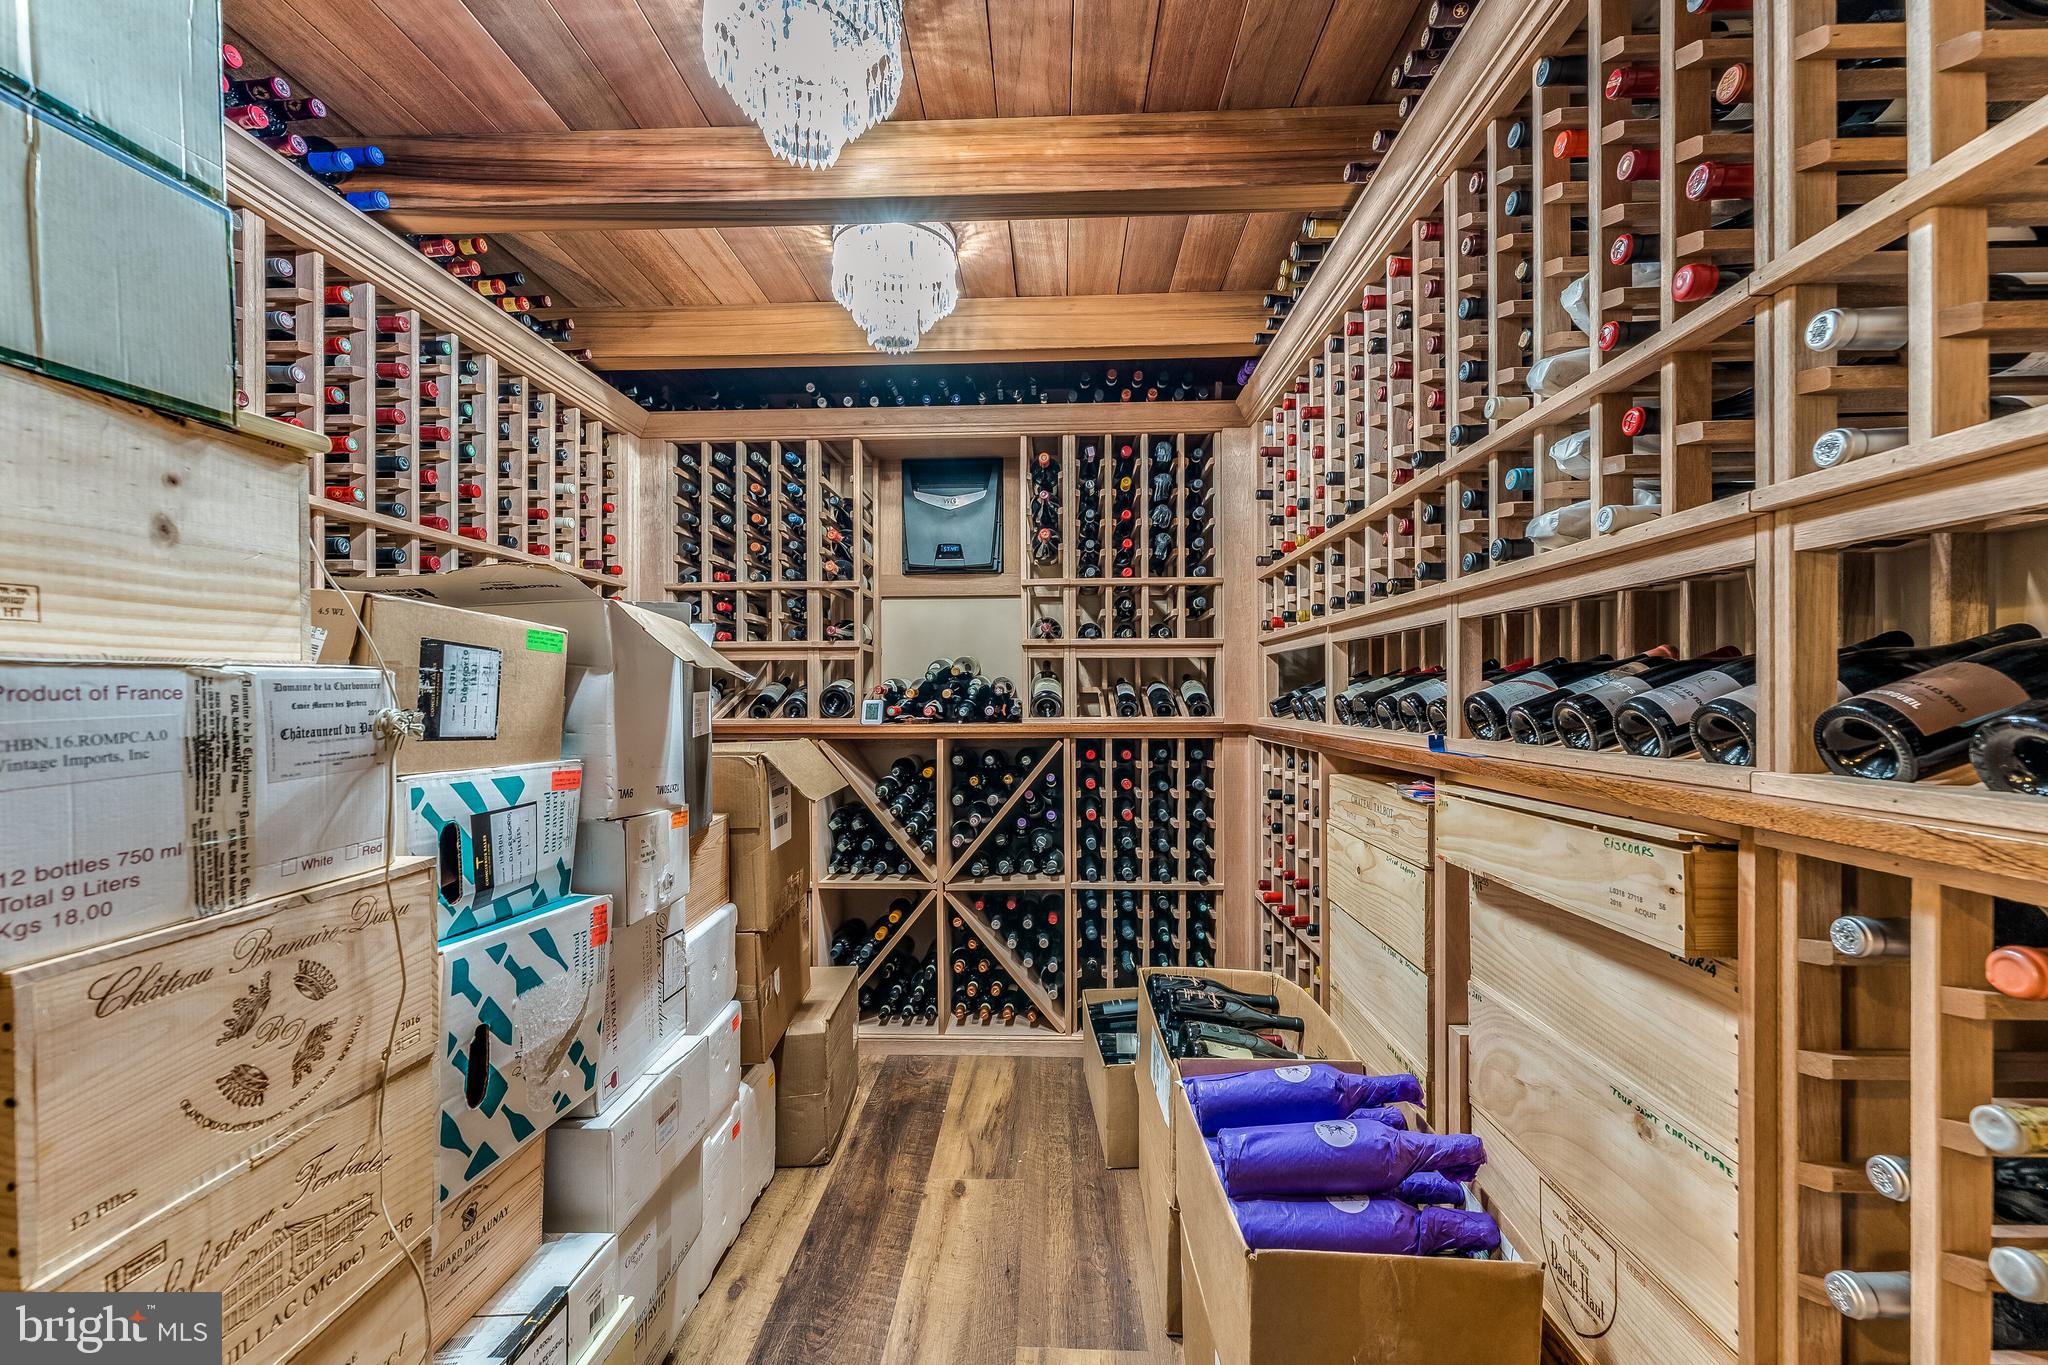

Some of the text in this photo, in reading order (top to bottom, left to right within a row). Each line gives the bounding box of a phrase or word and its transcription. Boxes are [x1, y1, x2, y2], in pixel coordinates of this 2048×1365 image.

[4, 607, 24, 617] HT
[332, 607, 345, 616] WL
[88, 685, 109, 701] of
[116, 685, 183, 701] France
[273, 682, 311, 692] Domaine
[313, 682, 322, 691] de
[324, 682, 332, 691] la
[280, 724, 342, 742] Châteauneuf
[345, 723, 356, 735] du
[62, 751, 125, 769] Imports,
[128, 749, 150, 761] Inc
[558, 800, 566, 850] winning
[362, 843, 383, 857] Red
[551, 831, 559, 852] our
[0, 842, 182, 888] 12 bottles 750 ml
[301, 854, 334, 872] White
[0, 875, 140, 914] Total 9 Liters
[53, 901, 113, 928] 18,00
[1634, 907, 1657, 920] ACQUIT
[88, 962, 215, 1019] Château
[400, 1015, 421, 1032] 2016
[70, 1211, 91, 1233] 12
[464, 1203, 511, 1252] DELAUNAY
[303, 1244, 366, 1308] (Médoc)
